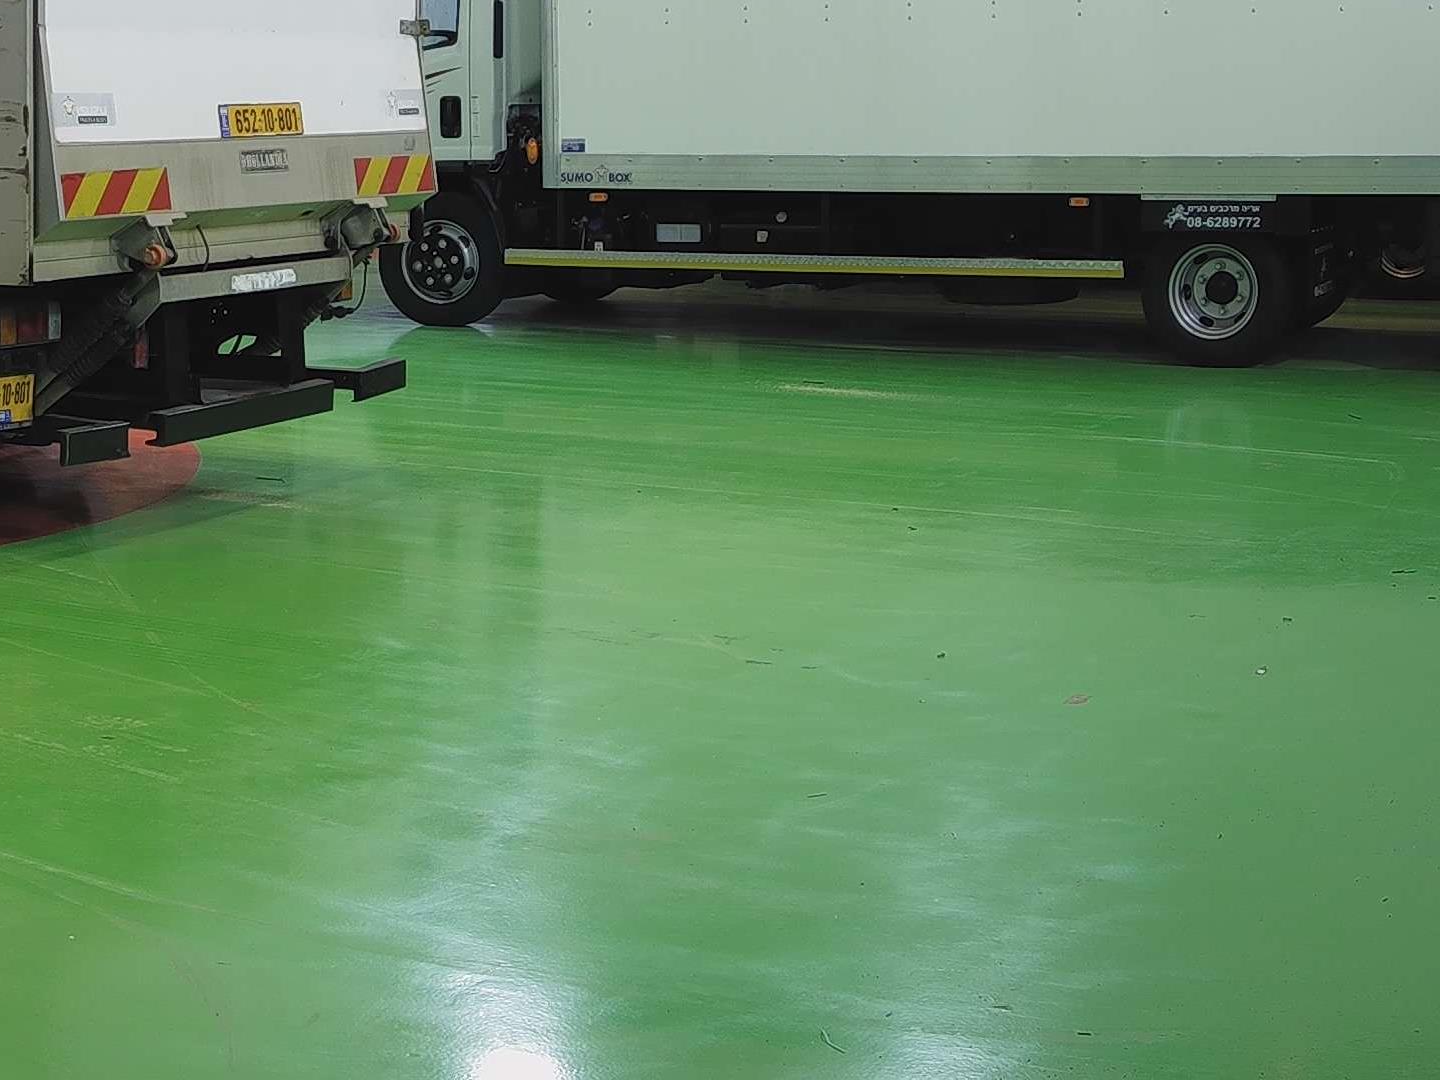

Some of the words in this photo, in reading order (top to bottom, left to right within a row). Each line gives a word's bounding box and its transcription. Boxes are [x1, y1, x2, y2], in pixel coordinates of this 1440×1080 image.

[561, 172, 593, 183] SUMO
[608, 172, 633, 183] BOX
[1186, 216, 1261, 228] 08-6289772
